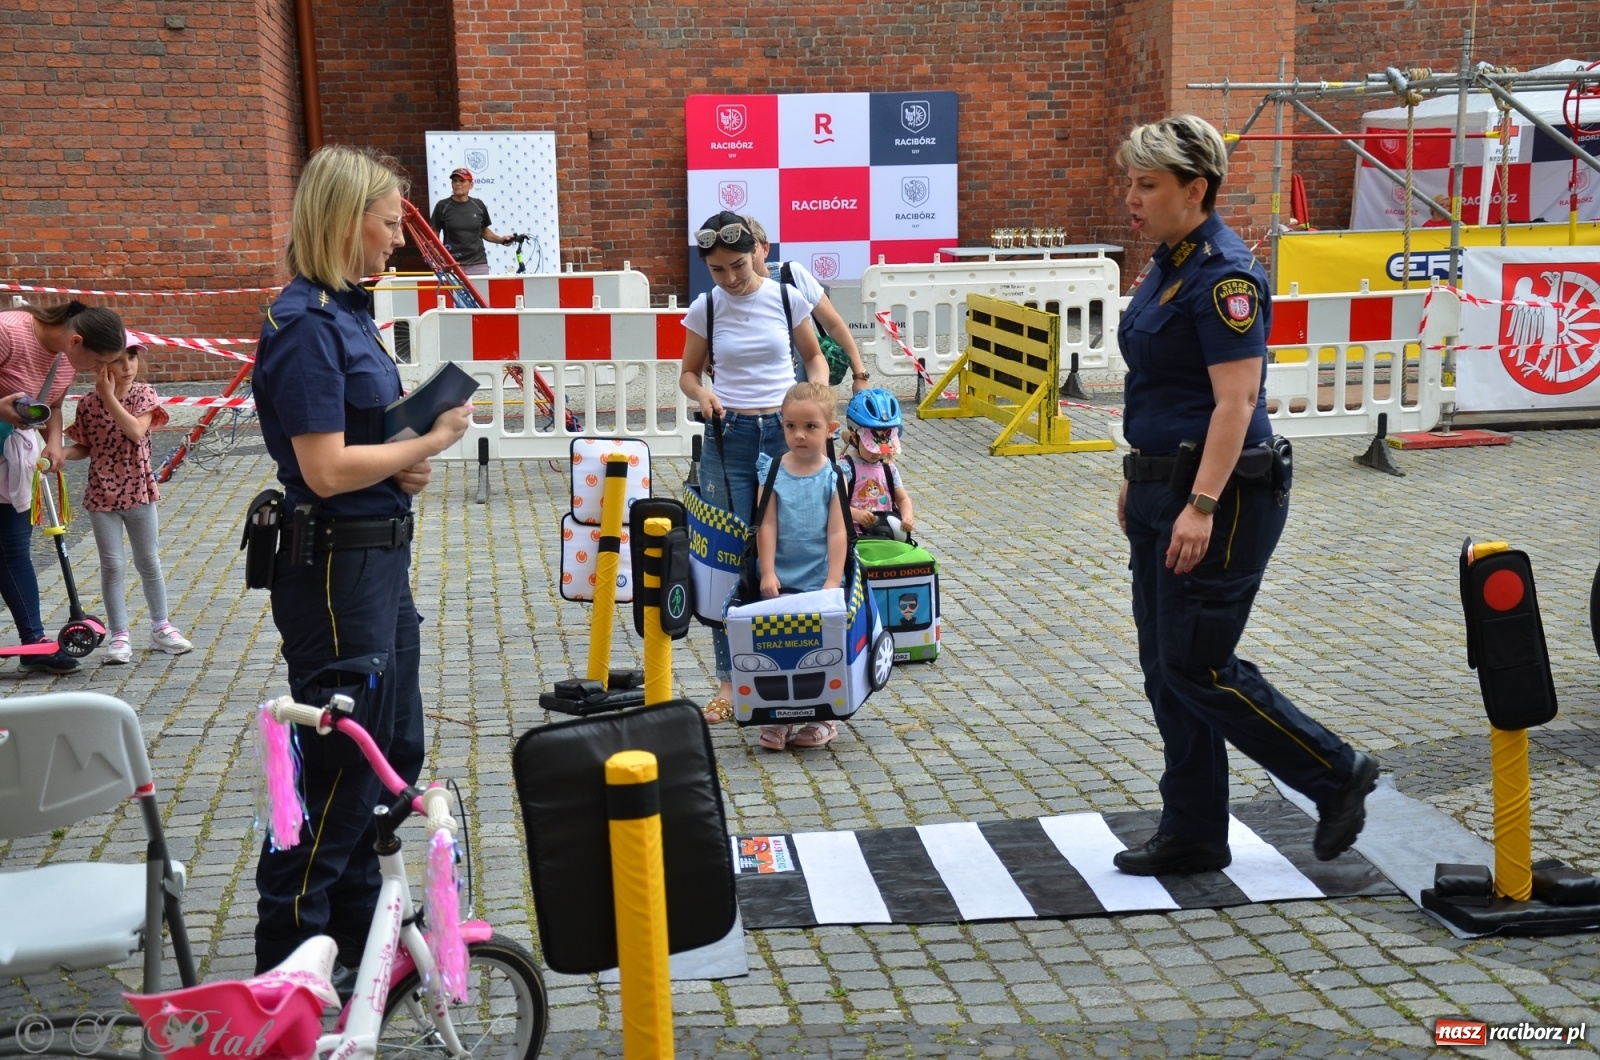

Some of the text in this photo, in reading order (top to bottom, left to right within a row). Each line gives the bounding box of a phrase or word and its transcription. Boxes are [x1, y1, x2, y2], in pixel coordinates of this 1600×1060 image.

[814, 113, 833, 135] R
[710, 140, 754, 150] RACIBÓRZ
[894, 136, 936, 146] RACIBÓRZ
[791, 196, 858, 211] RACIBÓRZ
[895, 210, 936, 220] RACIBÓRZ
[900, 566, 931, 576] DROGI
[756, 639, 820, 650] STRAŻ MIEJSKA
